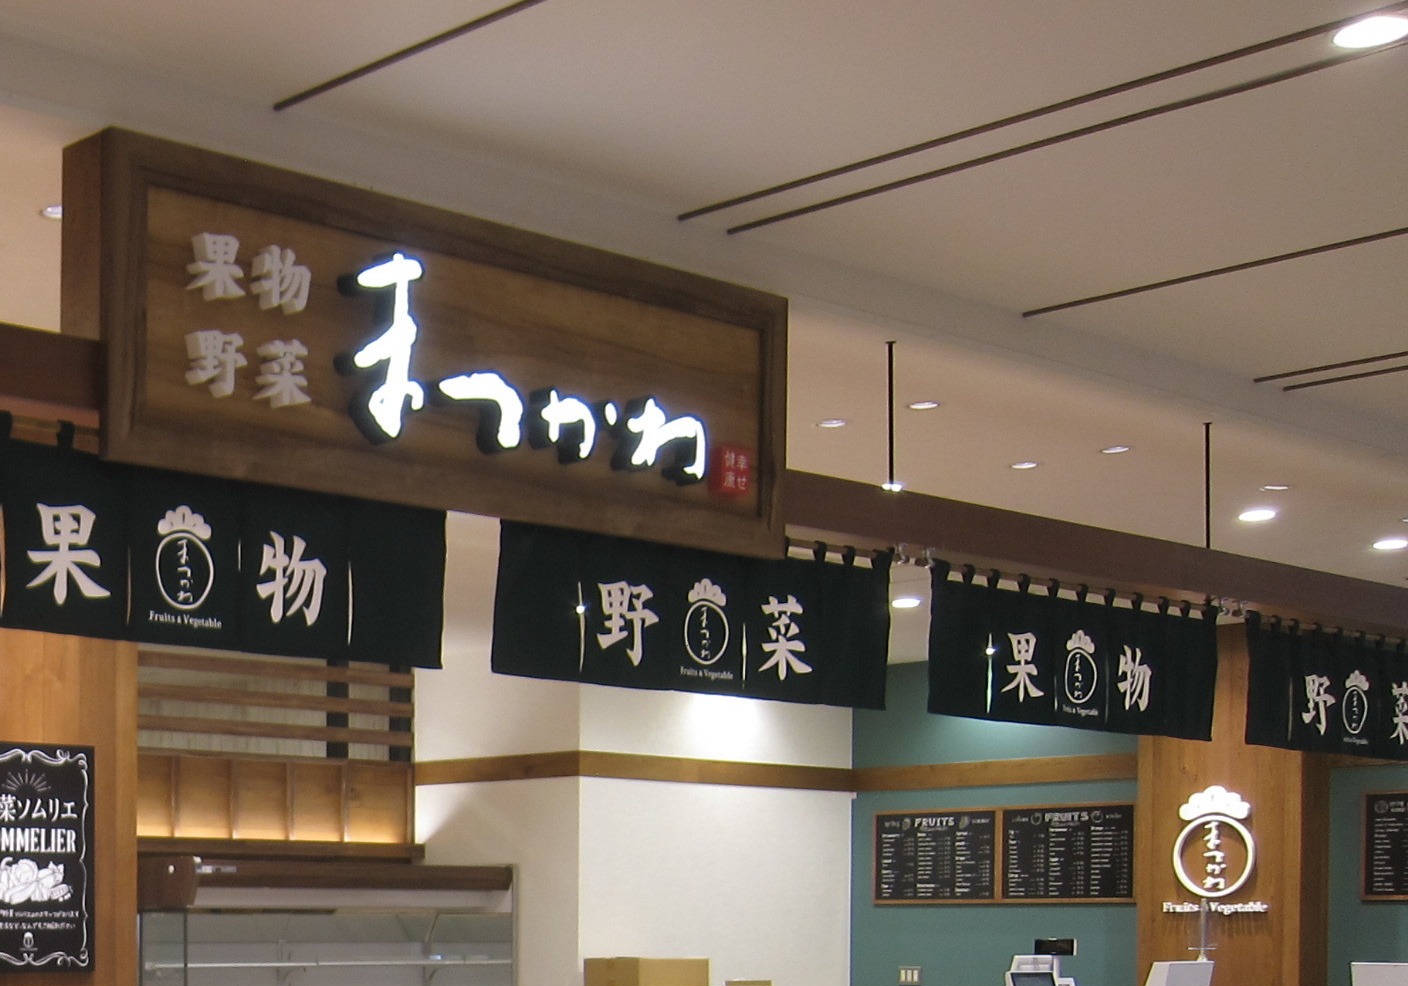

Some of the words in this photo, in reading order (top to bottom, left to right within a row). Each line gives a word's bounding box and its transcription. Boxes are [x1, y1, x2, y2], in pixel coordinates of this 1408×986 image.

[185, 232, 312, 315] 果物
[184, 329, 312, 409] 野菜
[354, 252, 707, 480] まつかわ
[27, 503, 111, 605] 果
[256, 531, 327, 627] 物
[177, 538, 194, 603] まつかわ
[148, 609, 176, 623] Fruits
[183, 613, 223, 629] Vegetable
[596, 581, 660, 667] 野
[758, 595, 813, 681] 菜
[1001, 632, 1045, 703] 果
[1117, 645, 1152, 712] 物
[1301, 674, 1336, 736] 野
[914, 816, 955, 828] FRUITS
[1044, 811, 1090, 823] FRUITS
[1201, 821, 1227, 890] まつかわ
[1162, 900, 1200, 913] Fruits
[1209, 900, 1270, 916] Vegetable
